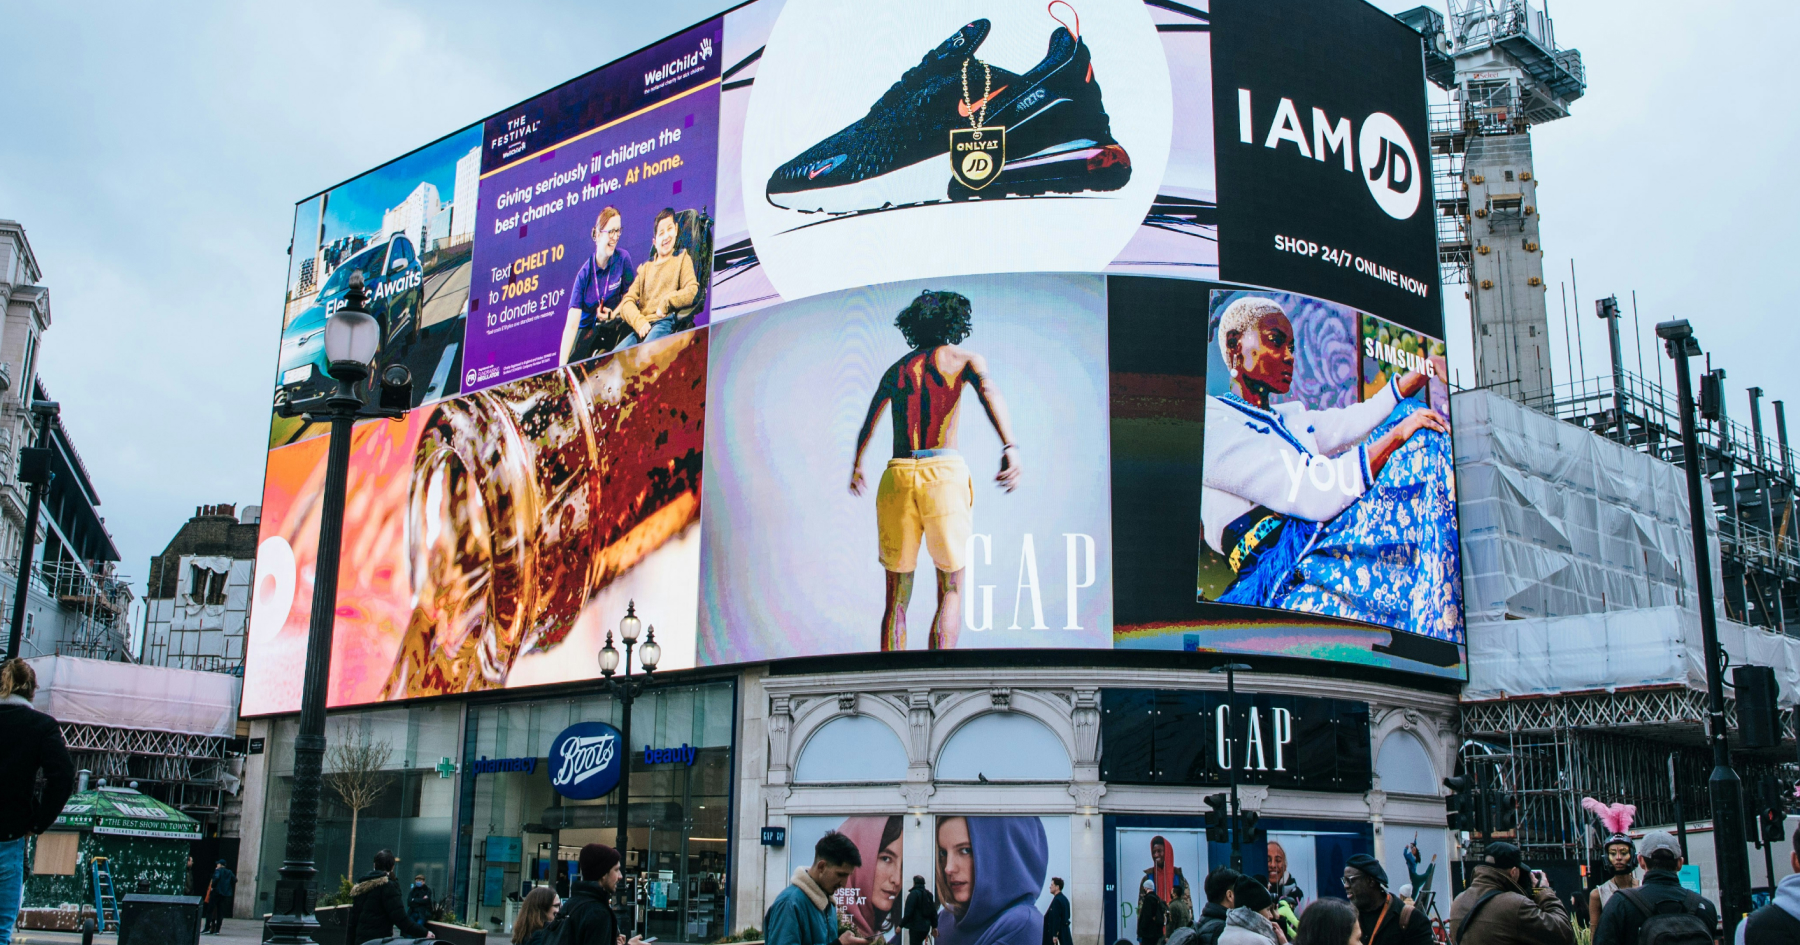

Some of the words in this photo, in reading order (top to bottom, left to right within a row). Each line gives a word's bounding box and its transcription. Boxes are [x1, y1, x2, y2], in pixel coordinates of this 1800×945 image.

[644, 51, 698, 86] WellChild
[507, 115, 526, 131] THE
[1238, 88, 1252, 144] I
[1264, 97, 1354, 173] AM
[1369, 135, 1412, 194] JD
[496, 184, 533, 210] Giving
[535, 162, 588, 196] seriously
[590, 154, 602, 174] ill
[604, 138, 656, 169] children
[658, 128, 682, 148] the
[966, 158, 989, 173] JD
[495, 214, 520, 235] best
[521, 198, 564, 225] chance
[566, 191, 580, 208] to
[582, 177, 622, 202] thrive.
[624, 166, 640, 187] At
[642, 154, 684, 179] home.
[491, 263, 513, 283] Text
[513, 248, 549, 275] CHELT
[551, 244, 565, 263] 10
[1274, 234, 1319, 257] SHOP
[1321, 246, 1352, 267] 24/7
[1354, 257, 1399, 286] ONLINE
[1399, 274, 1428, 298] NOW
[374, 270, 422, 302] Awaits
[488, 290, 500, 306] to
[501, 274, 539, 301] 70085
[487, 312, 497, 328] to
[499, 299, 538, 323] donate
[1365, 337, 1435, 378] SAMSUNG
[1279, 448, 1361, 503] you
[965, 533, 1096, 632] GAP
[644, 743, 698, 766] beauty
[1215, 704, 1291, 771] GAP
[472, 755, 538, 777] pharmacy
[553, 733, 615, 786] Boots
[122, 819, 139, 828] BEST
[139, 821, 158, 829] SHOW
[846, 896, 854, 905] IS
[855, 896, 867, 905] AT
[1106, 884, 1115, 892] GAP
